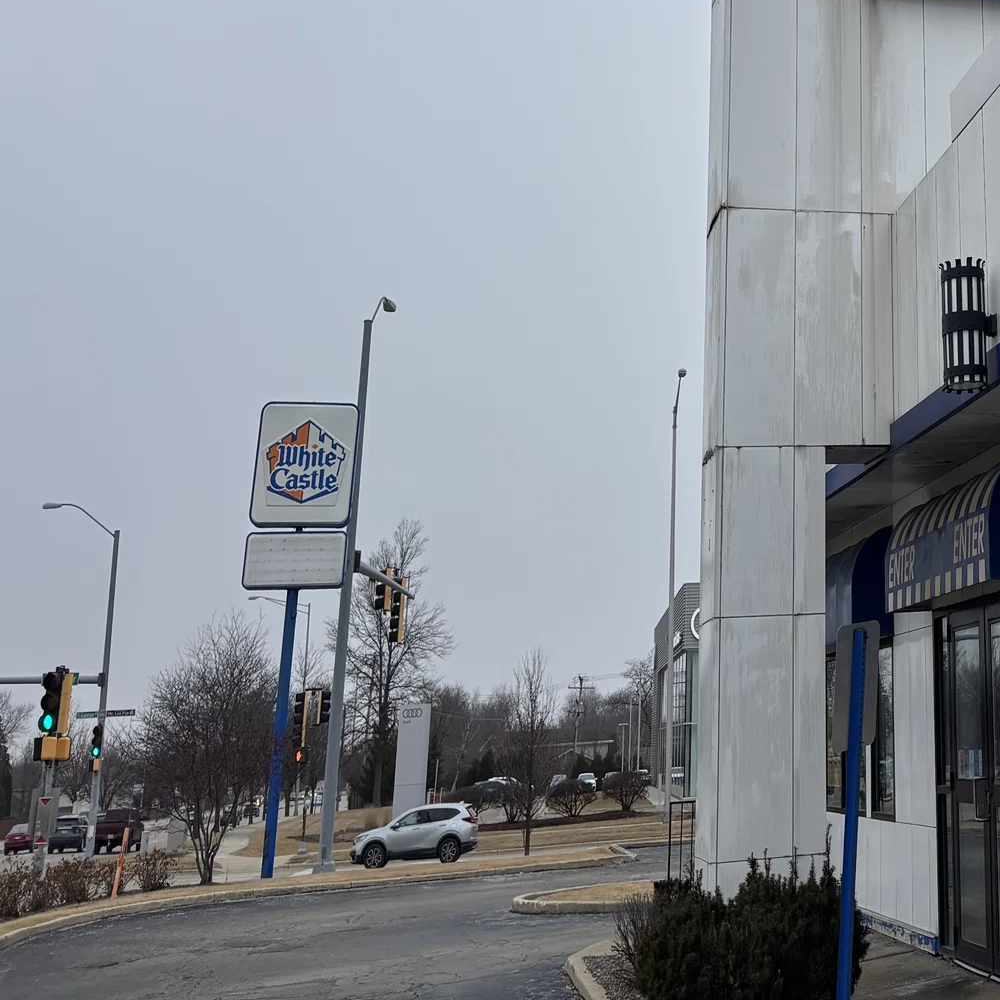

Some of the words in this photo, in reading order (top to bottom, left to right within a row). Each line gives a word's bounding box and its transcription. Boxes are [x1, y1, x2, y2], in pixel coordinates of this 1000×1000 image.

[277, 445, 336, 471] White
[271, 468, 336, 490] Castle
[954, 513, 985, 563] ENTER
[888, 545, 915, 588] ENTER
